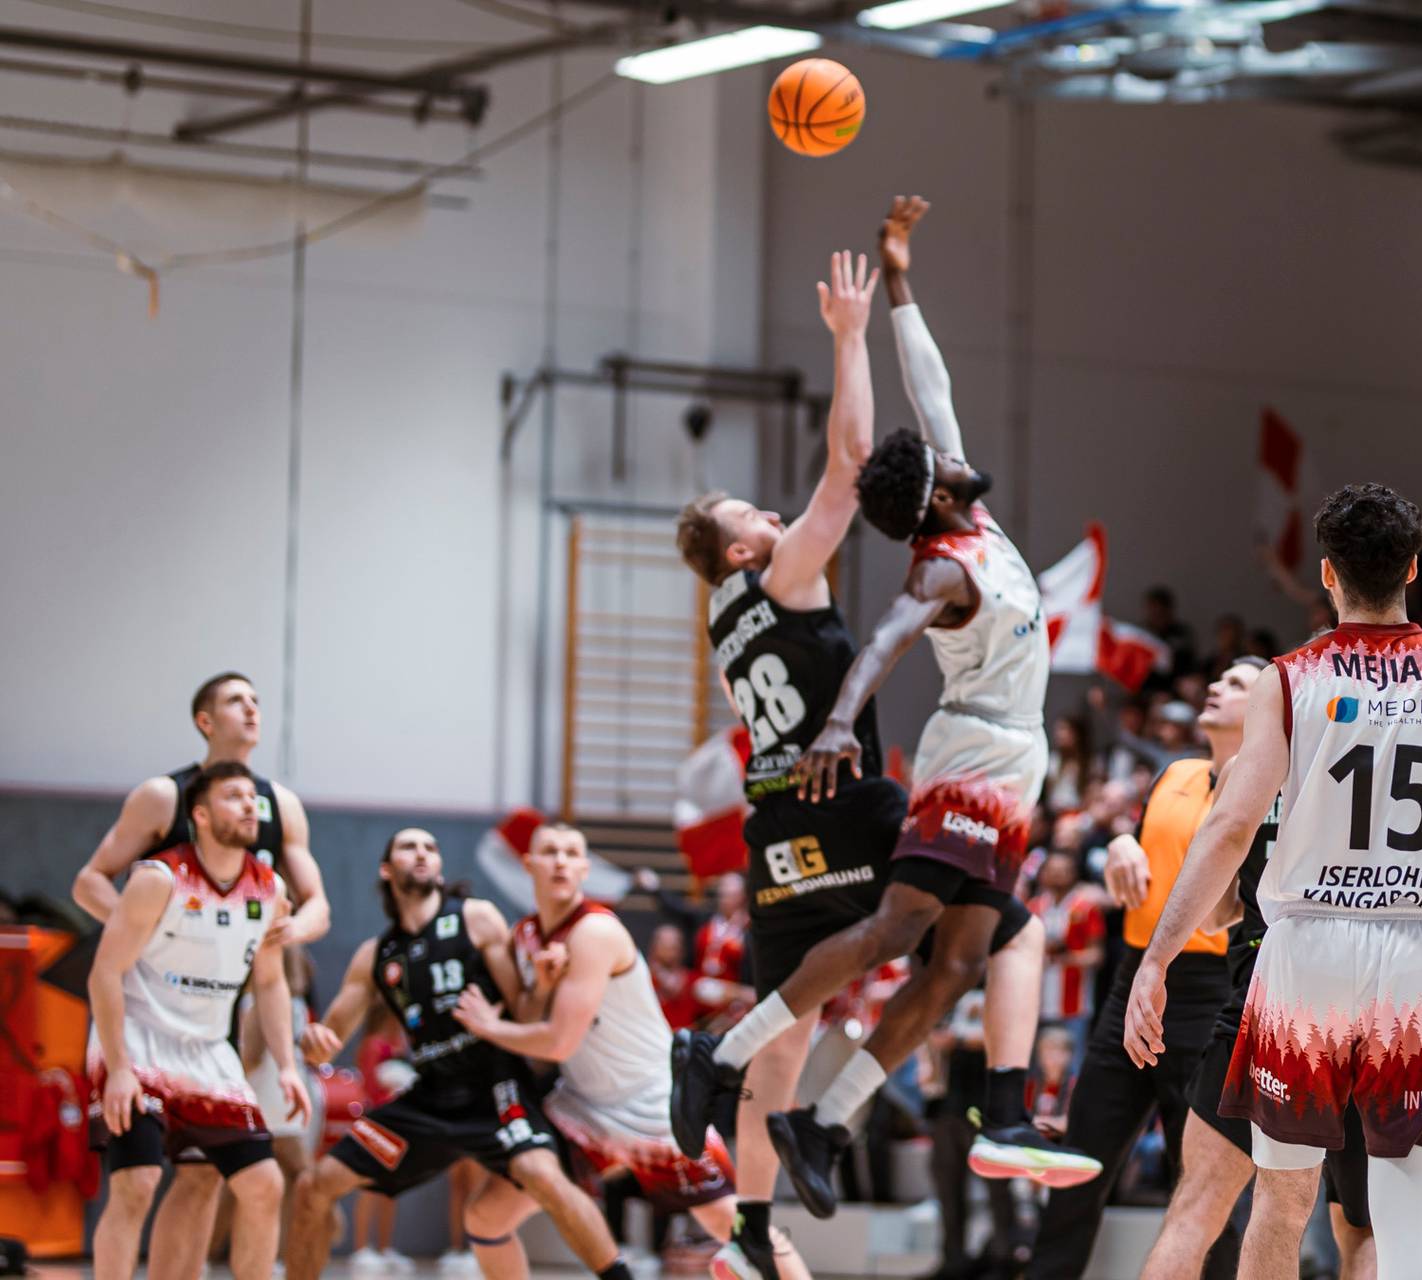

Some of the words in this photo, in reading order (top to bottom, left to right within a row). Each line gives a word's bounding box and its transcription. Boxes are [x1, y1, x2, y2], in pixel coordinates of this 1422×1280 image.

[734, 653, 806, 756] 28
[1368, 719, 1384, 728] THE
[430, 958, 464, 995] 13
[1249, 1055, 1291, 1102] better.
